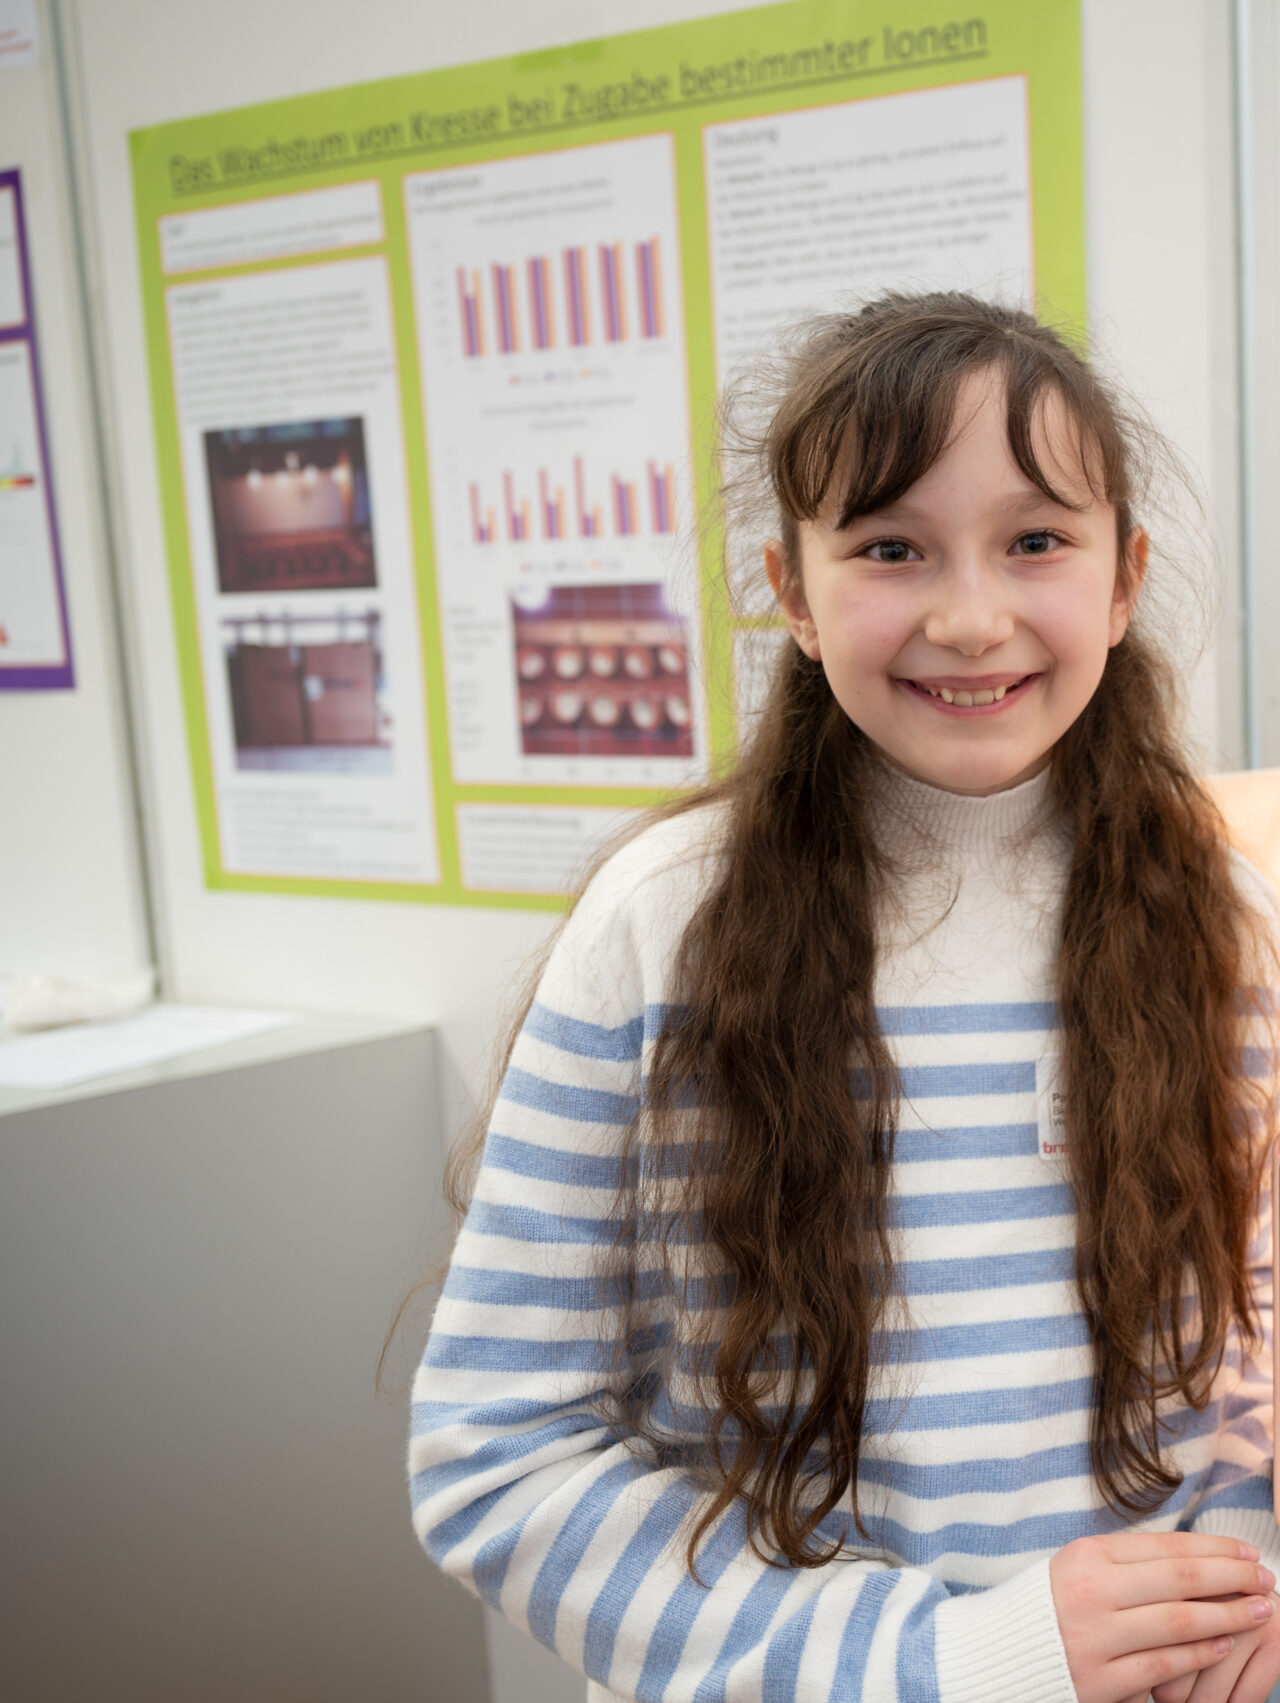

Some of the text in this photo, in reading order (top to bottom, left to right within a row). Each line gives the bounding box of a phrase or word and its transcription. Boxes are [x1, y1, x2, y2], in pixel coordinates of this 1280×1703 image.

[217, 130, 348, 180] Wachstum
[353, 122, 405, 156] von
[408, 102, 500, 143] Kresse
[507, 84, 553, 130] bei
[561, 70, 672, 125] Zugabe
[678, 35, 874, 96] bestimmter
[883, 17, 988, 62] Ionen
